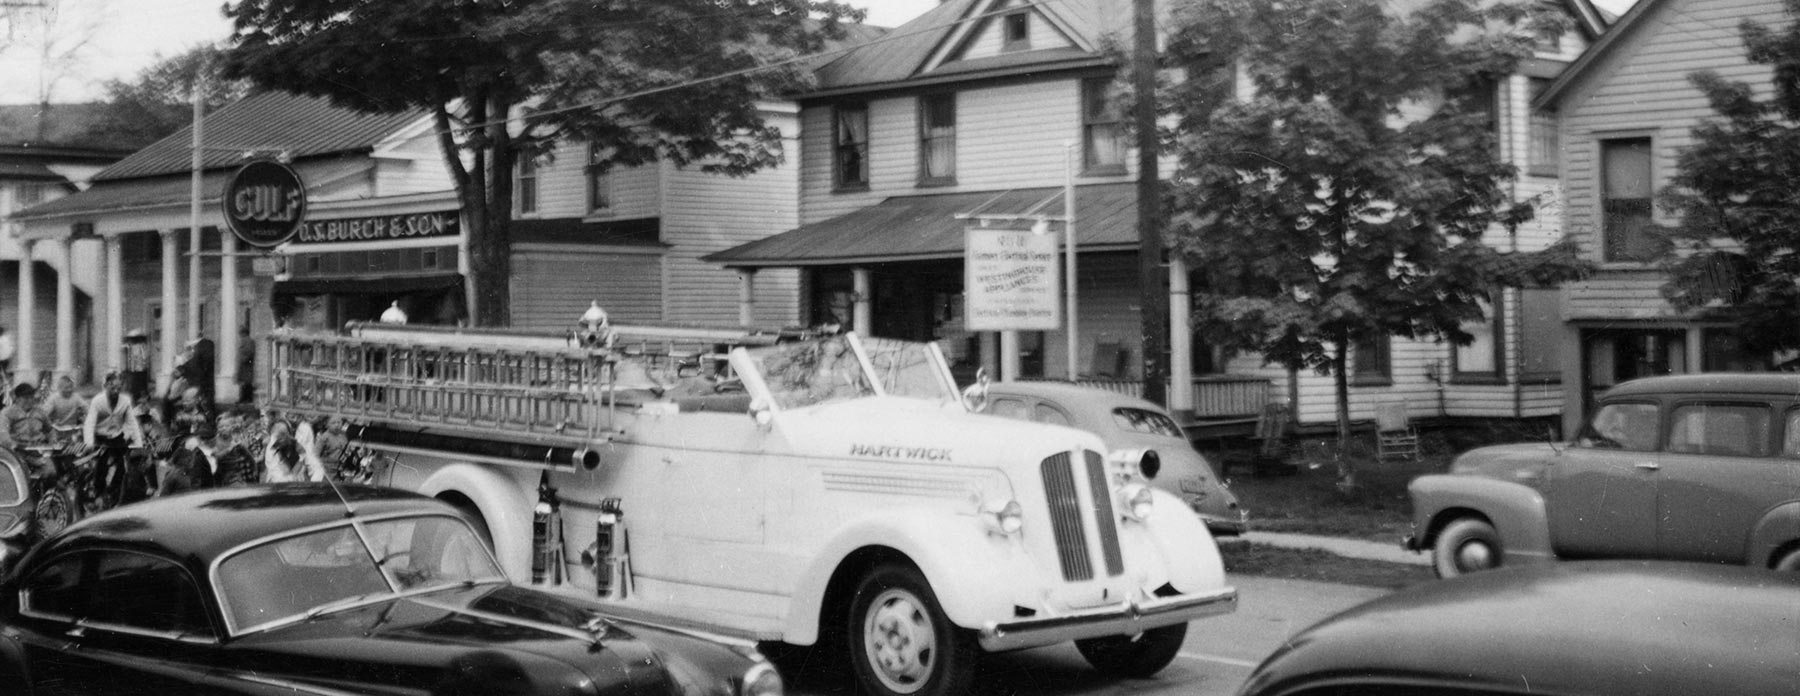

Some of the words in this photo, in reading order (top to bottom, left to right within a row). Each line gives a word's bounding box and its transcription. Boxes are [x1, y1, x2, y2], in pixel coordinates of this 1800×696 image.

[235, 184, 299, 221] GULF
[327, 214, 386, 241] BURCH
[389, 214, 406, 237] &
[405, 212, 443, 236] SON
[849, 443, 954, 461] HARTWICK
